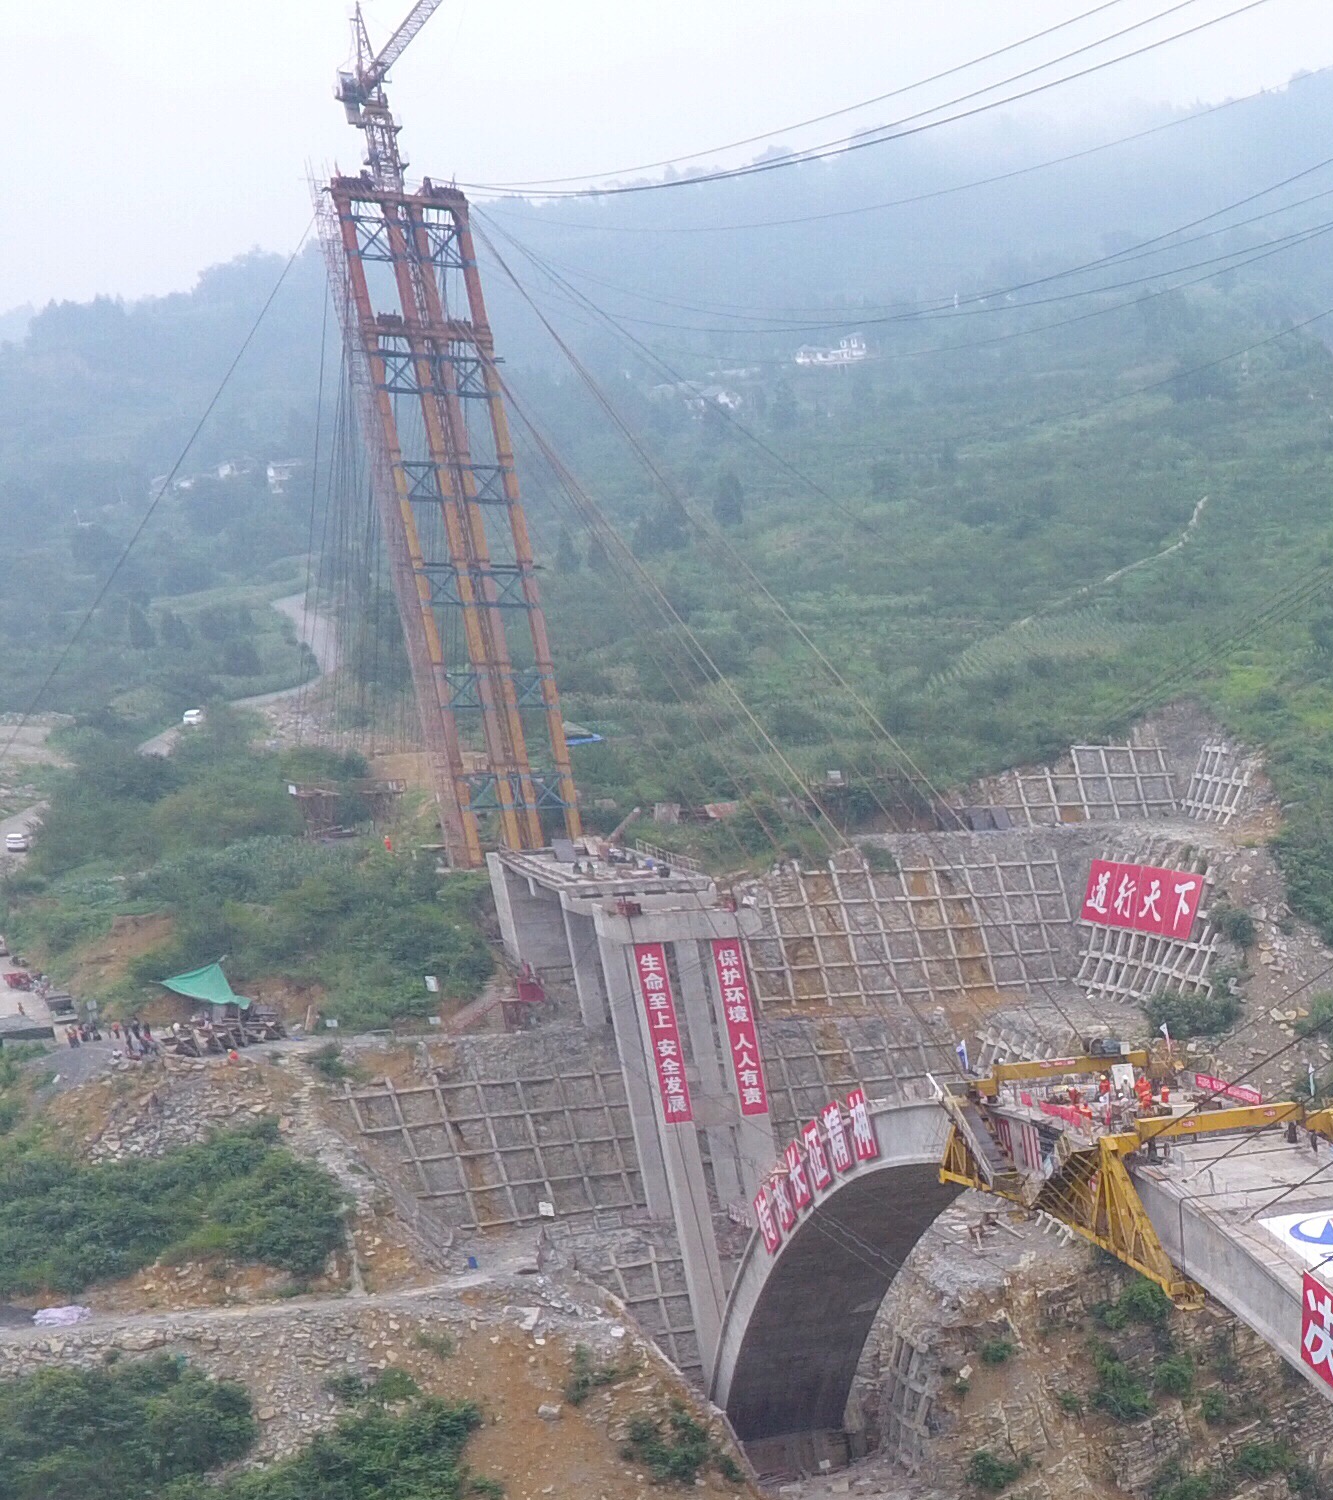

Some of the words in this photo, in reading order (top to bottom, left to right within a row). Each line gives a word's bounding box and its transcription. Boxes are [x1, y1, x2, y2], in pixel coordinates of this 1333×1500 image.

[1086, 870, 1196, 931] 道行天下
[640, 953, 673, 1029] 生命至上
[718, 948, 750, 1023] 保护环境
[734, 1033, 763, 1105] 人人有责
[656, 1038, 687, 1113] 安全发展
[755, 1093, 872, 1254] 传承长征精神
